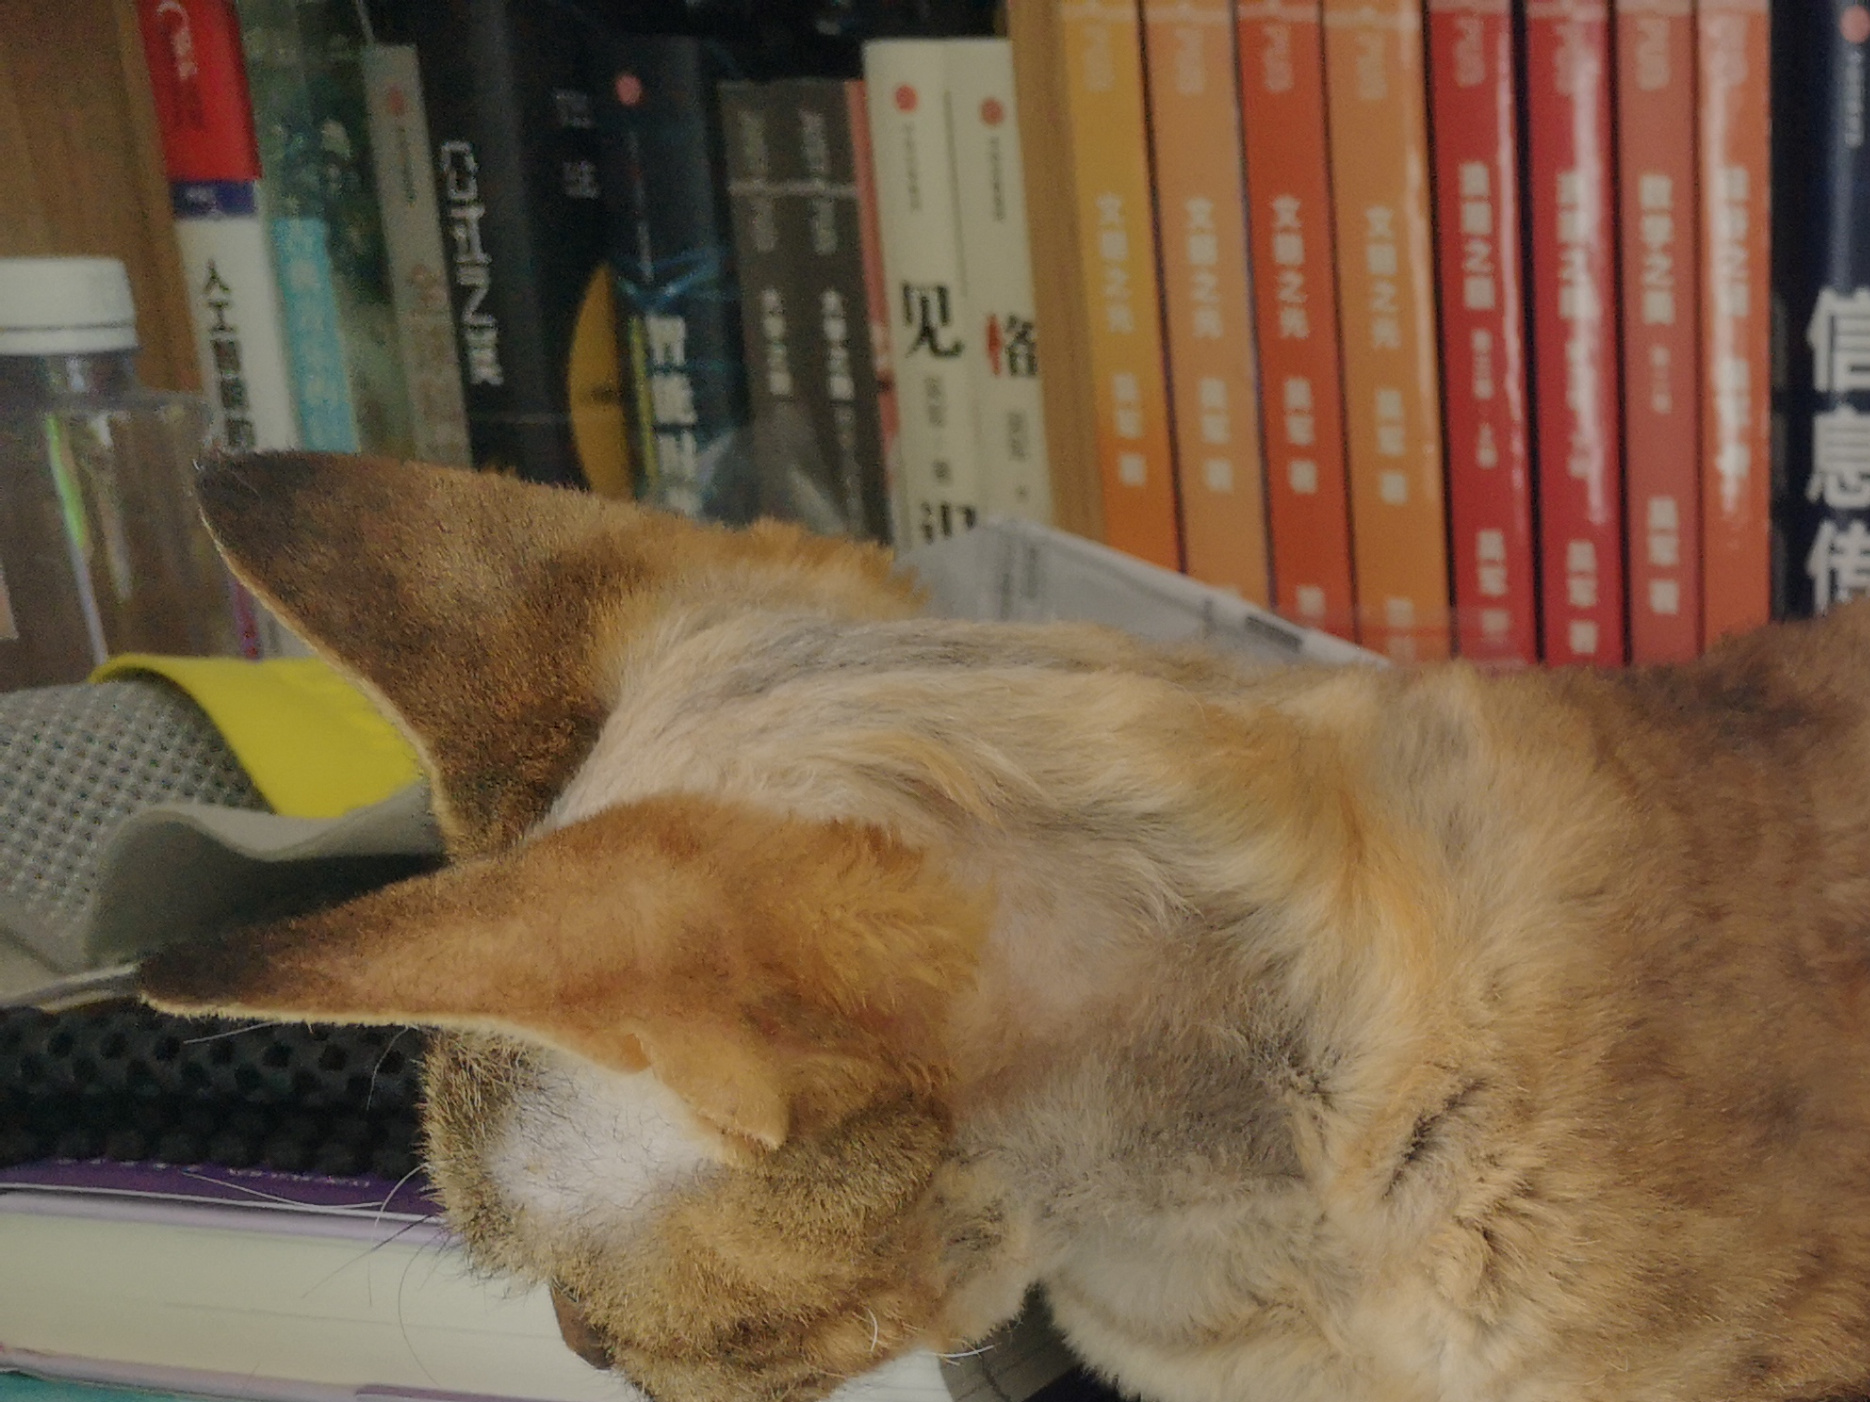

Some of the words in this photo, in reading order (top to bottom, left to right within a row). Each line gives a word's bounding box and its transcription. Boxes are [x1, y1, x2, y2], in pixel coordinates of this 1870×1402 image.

[1095, 191, 1135, 335] 文之光
[1185, 197, 1223, 341] 文之光
[1270, 194, 1311, 340] 文之光
[1365, 205, 1401, 351] 文之光
